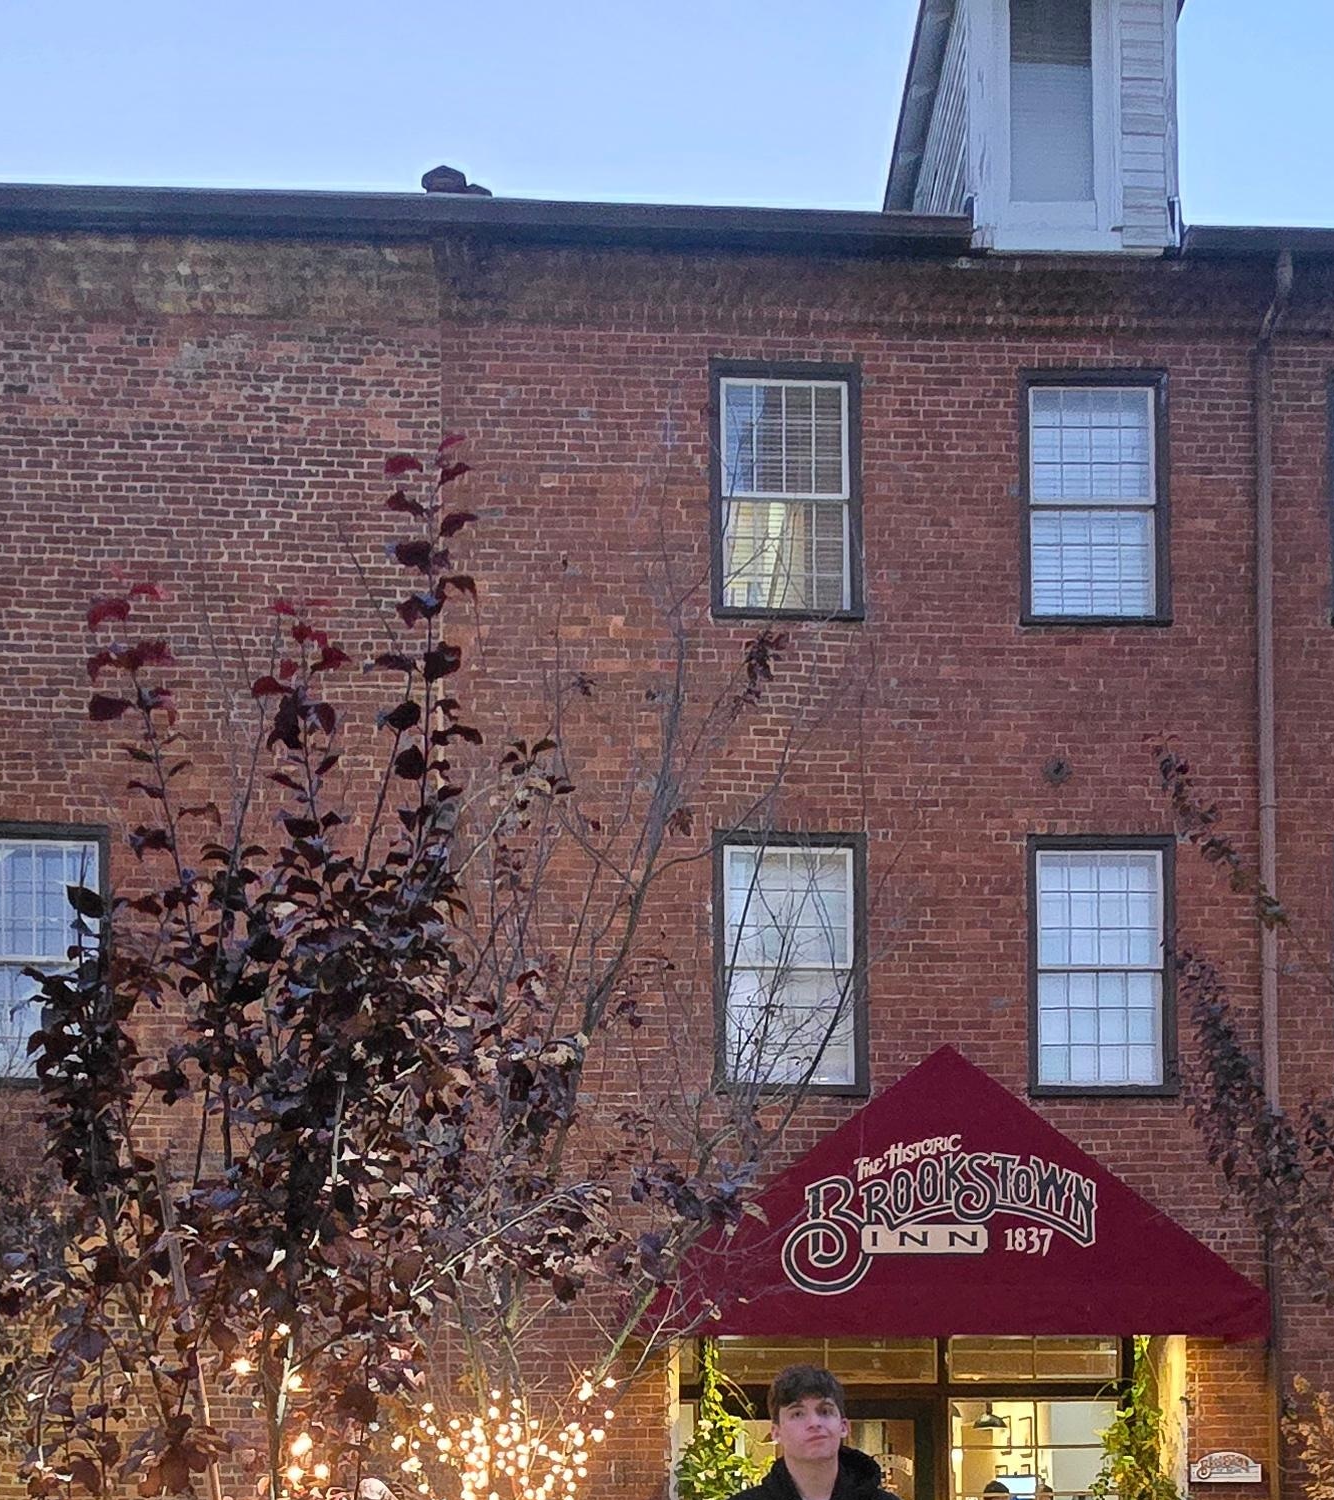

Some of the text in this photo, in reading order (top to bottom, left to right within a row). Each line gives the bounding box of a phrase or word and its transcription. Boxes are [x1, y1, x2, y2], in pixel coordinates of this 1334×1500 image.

[884, 1134, 962, 1169] HISTORIC
[781, 1152, 1098, 1296] BROOKSTOWN
[871, 1227, 1054, 1256] INN 1837
